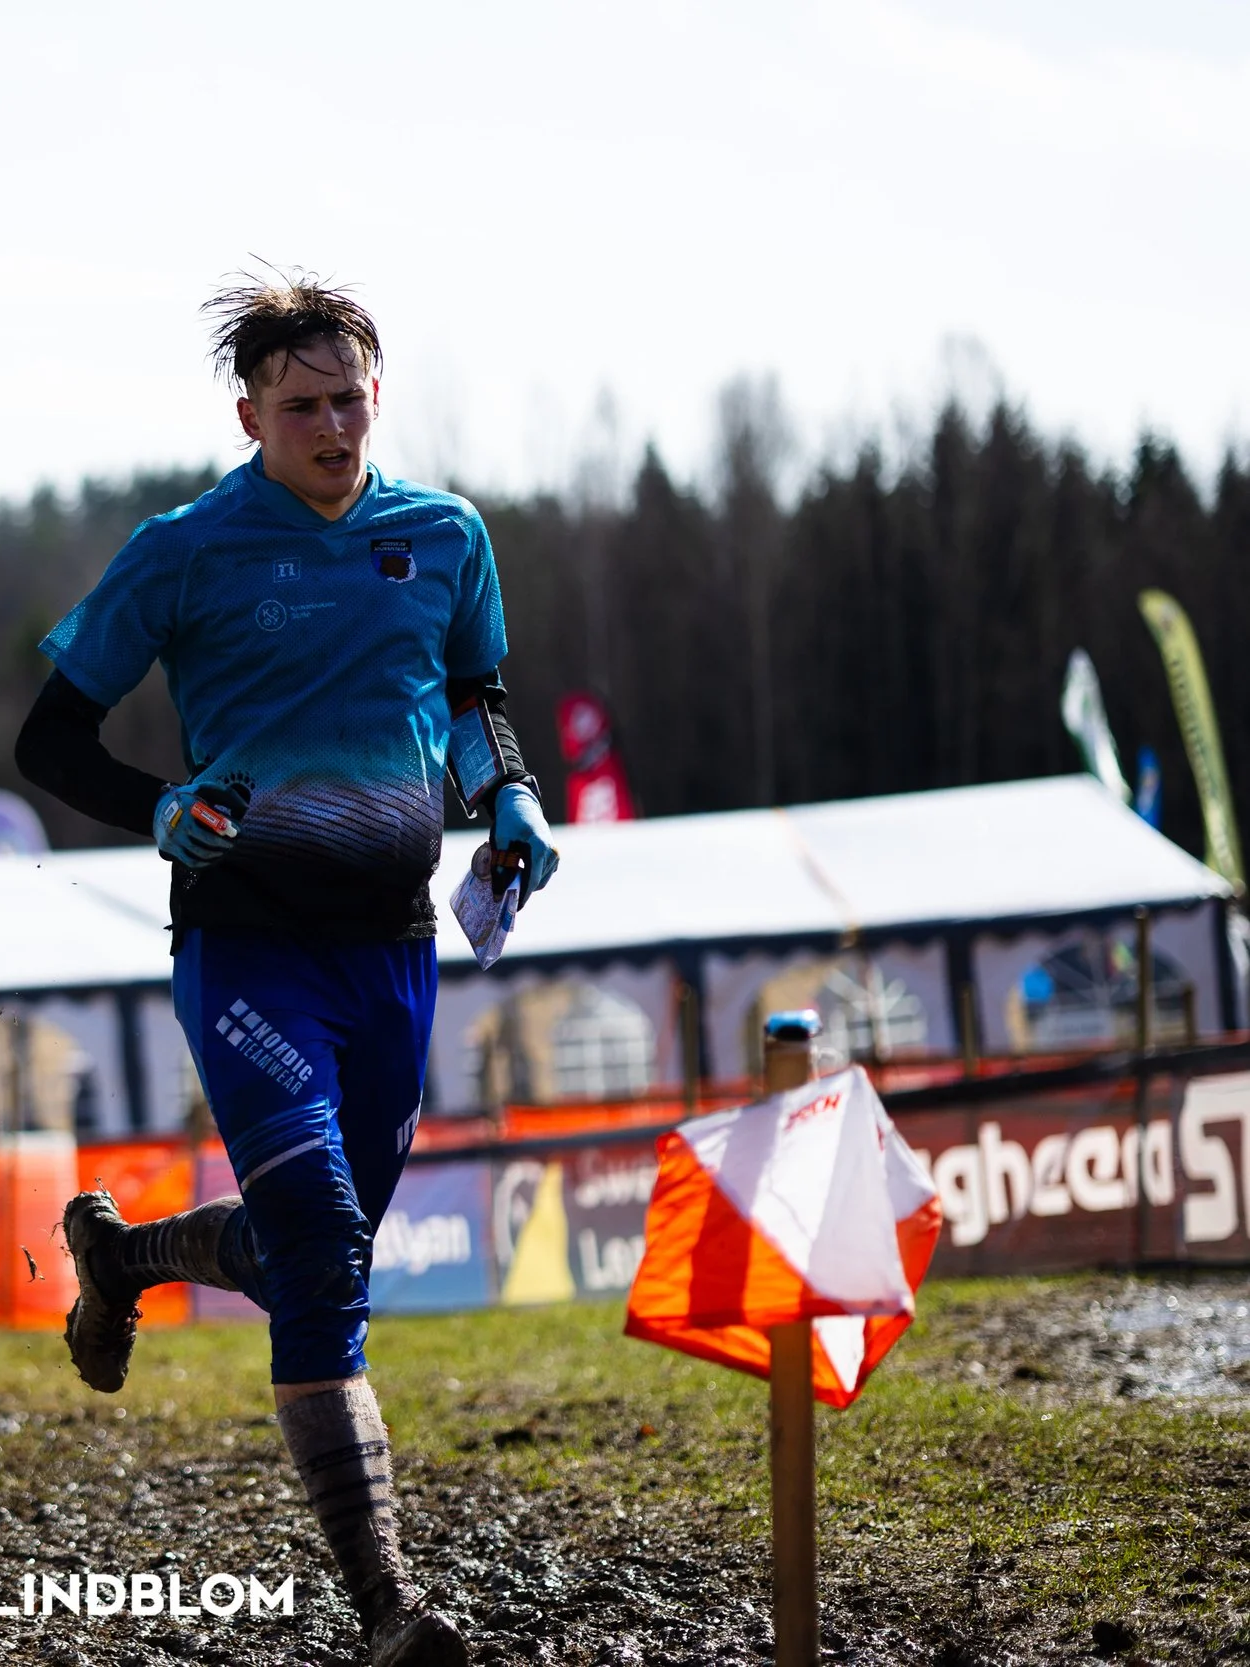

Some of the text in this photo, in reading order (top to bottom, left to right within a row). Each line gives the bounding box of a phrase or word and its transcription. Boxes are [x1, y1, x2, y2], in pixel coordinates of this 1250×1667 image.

[237, 1036, 304, 1096] TEAMWEAR
[251, 1021, 314, 1083] NORDIC
[914, 1120, 1176, 1247] gheera
